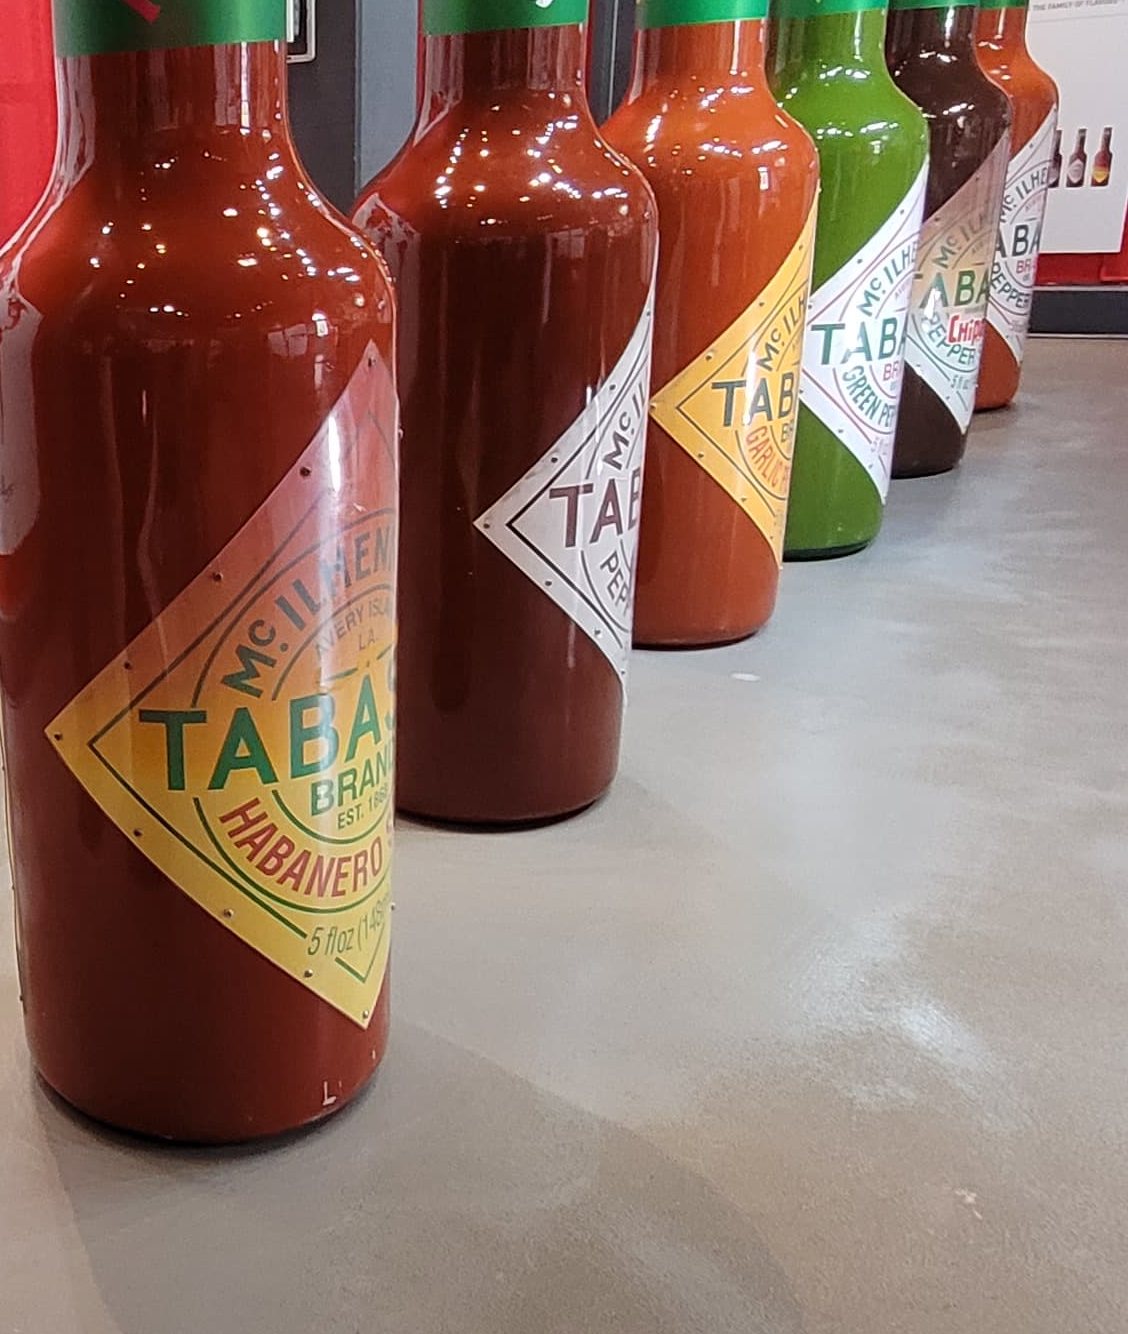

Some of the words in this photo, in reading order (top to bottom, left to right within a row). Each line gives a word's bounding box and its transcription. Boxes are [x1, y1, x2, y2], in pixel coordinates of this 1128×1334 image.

[842, 365, 882, 420] GREEN
[139, 659, 395, 791] TABA
[220, 797, 384, 899] HABANERO
